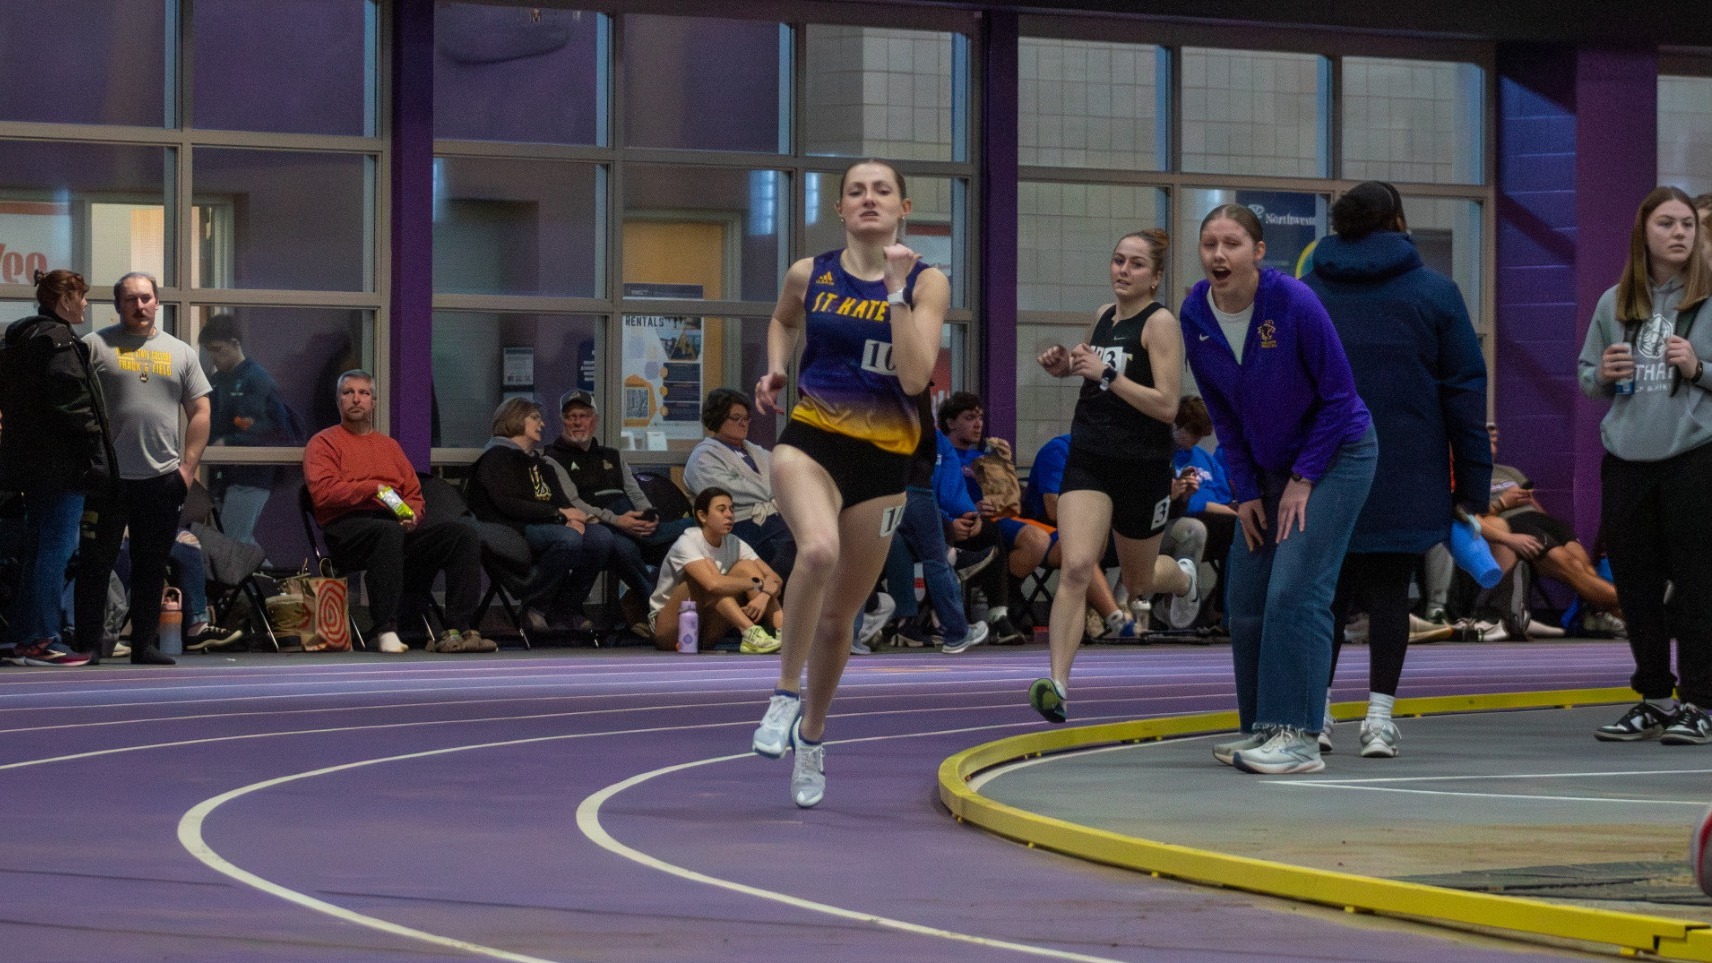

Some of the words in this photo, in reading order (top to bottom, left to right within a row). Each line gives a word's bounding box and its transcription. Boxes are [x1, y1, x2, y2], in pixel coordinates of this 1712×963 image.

[625, 316, 665, 328] RENTALS
[119, 359, 141, 372] TRACK
[152, 362, 173, 376] FIELD
[1152, 501, 1168, 524] 3
